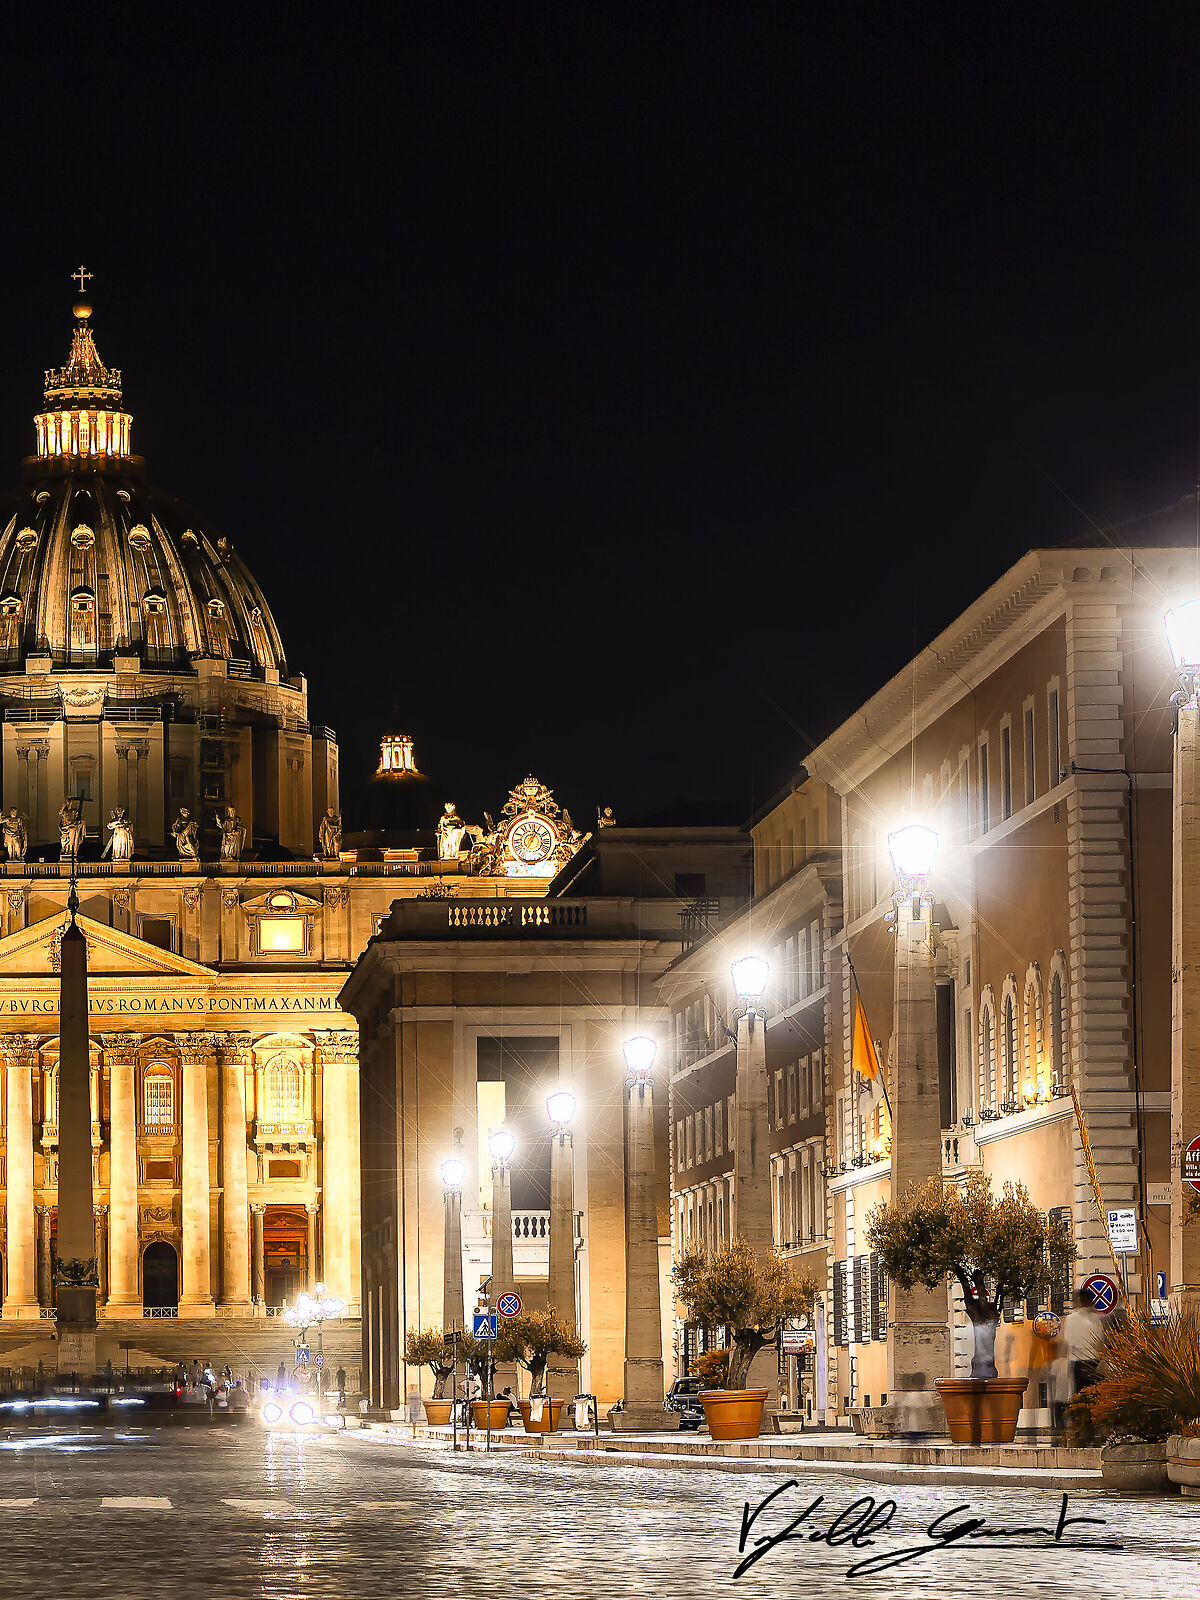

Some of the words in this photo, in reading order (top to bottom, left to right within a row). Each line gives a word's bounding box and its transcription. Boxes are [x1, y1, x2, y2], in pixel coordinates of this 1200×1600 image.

[119, 997, 205, 1011] ROMANVS
[209, 997, 252, 1010] PONT
[254, 997, 291, 1010] MAX
[293, 997, 316, 1010] AN
